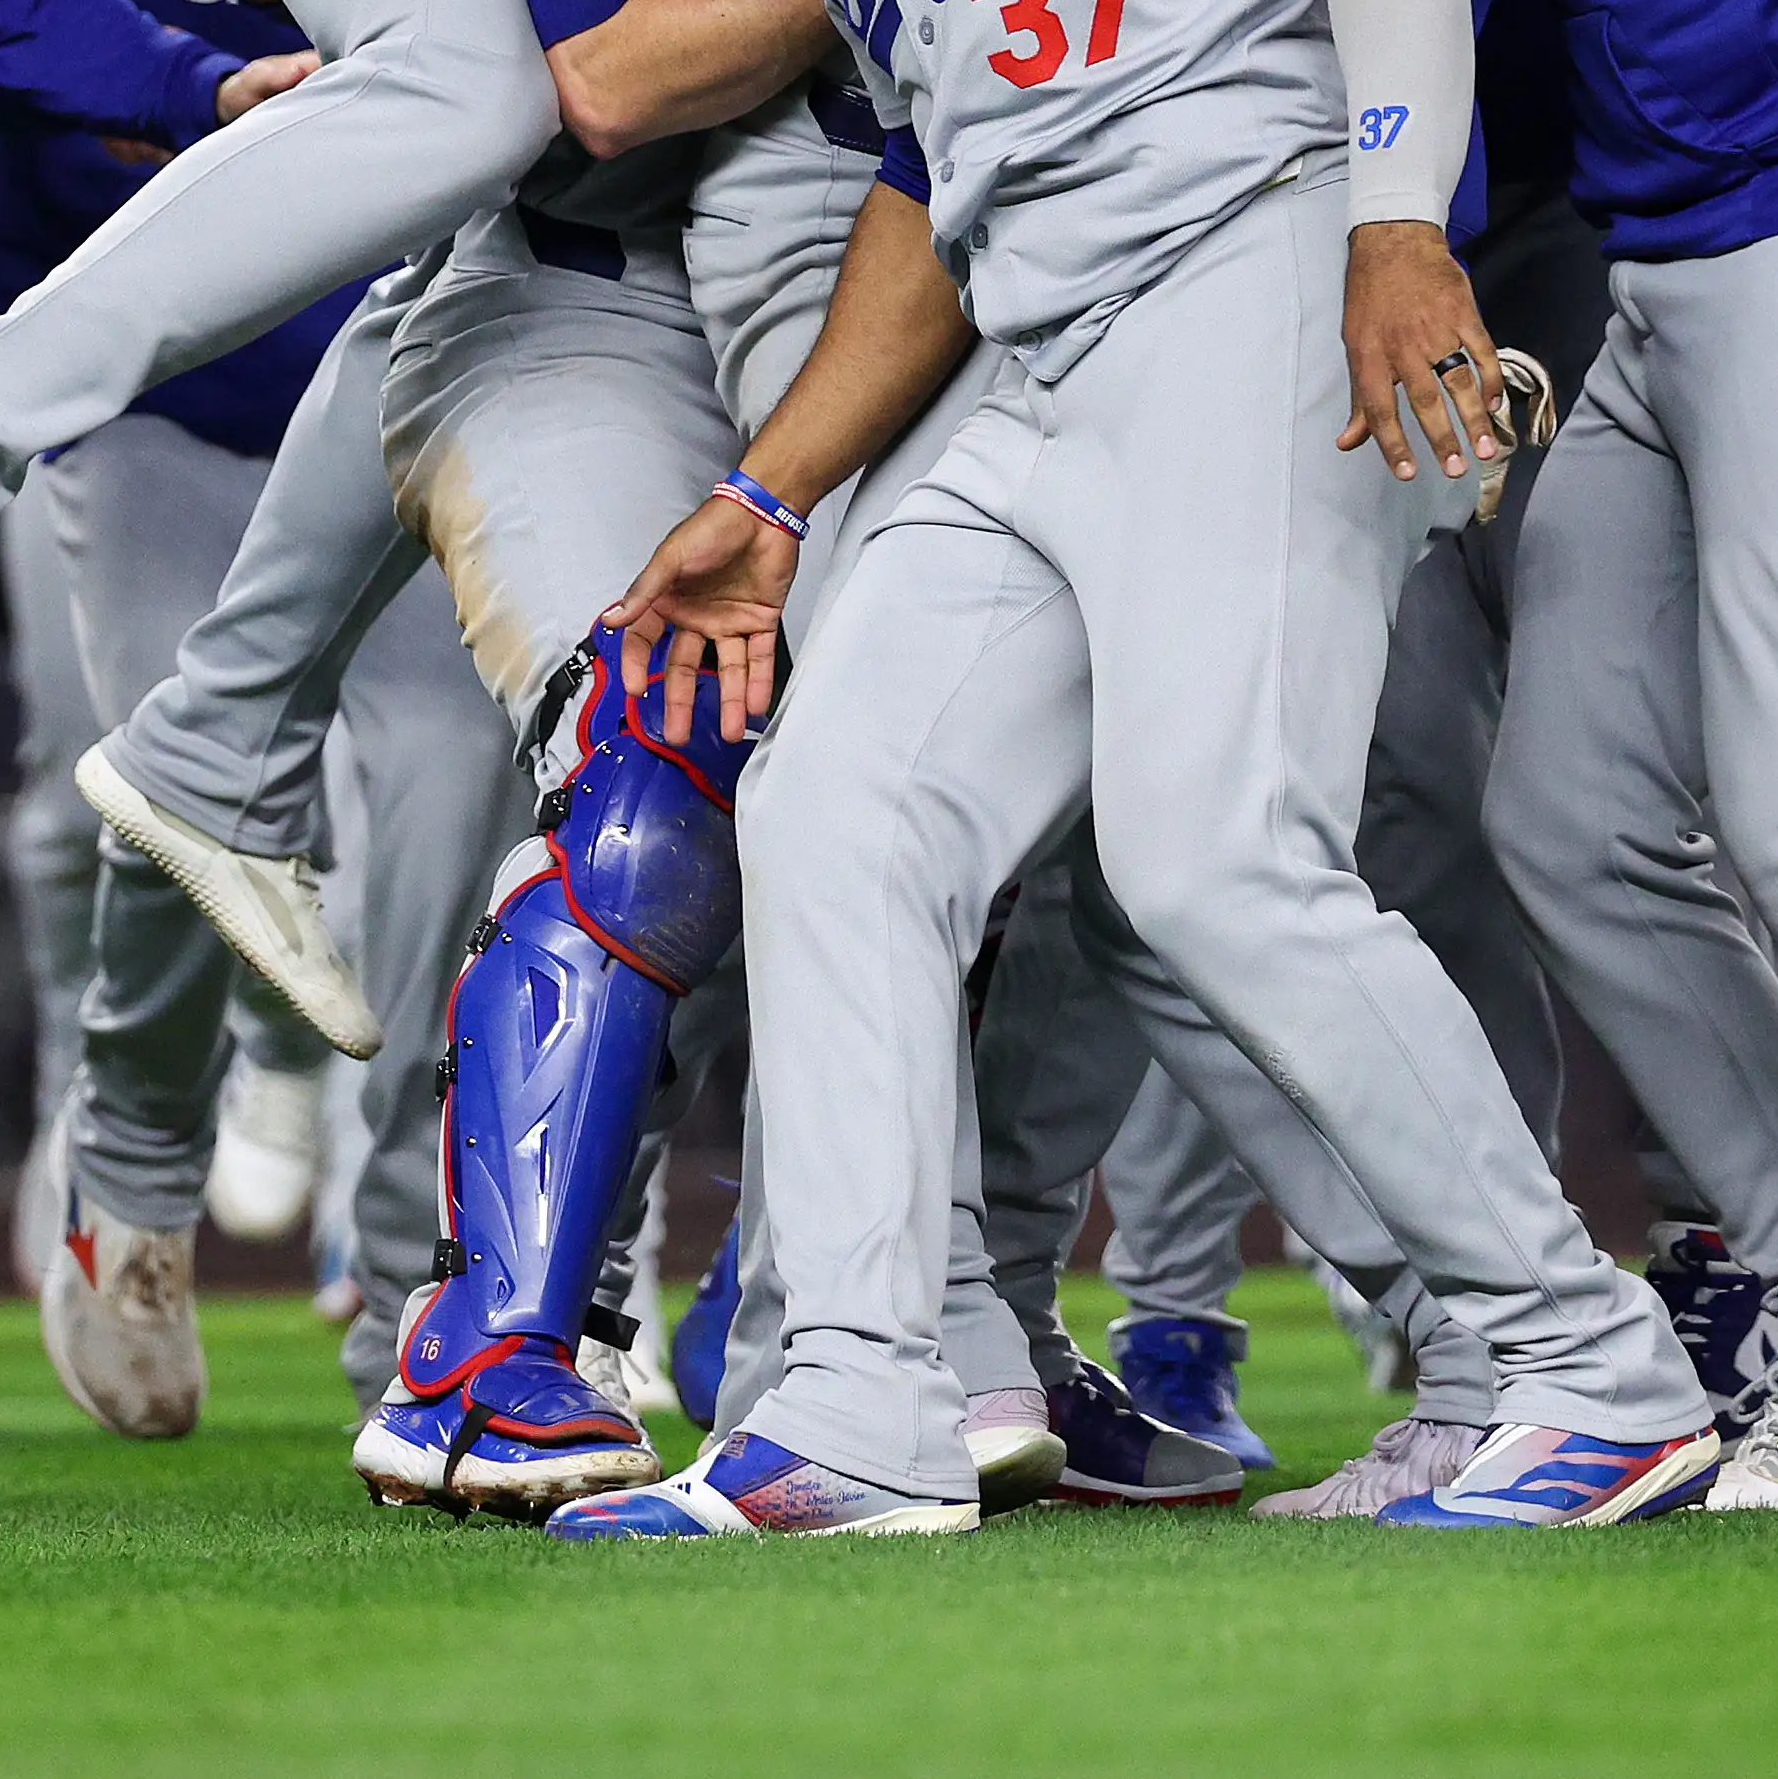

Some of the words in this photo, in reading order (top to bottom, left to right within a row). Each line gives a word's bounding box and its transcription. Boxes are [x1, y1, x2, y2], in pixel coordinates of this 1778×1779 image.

[1358, 105, 1410, 151] 37
[773, 506, 805, 534] REFUSE
[421, 1338, 441, 1361] 16
